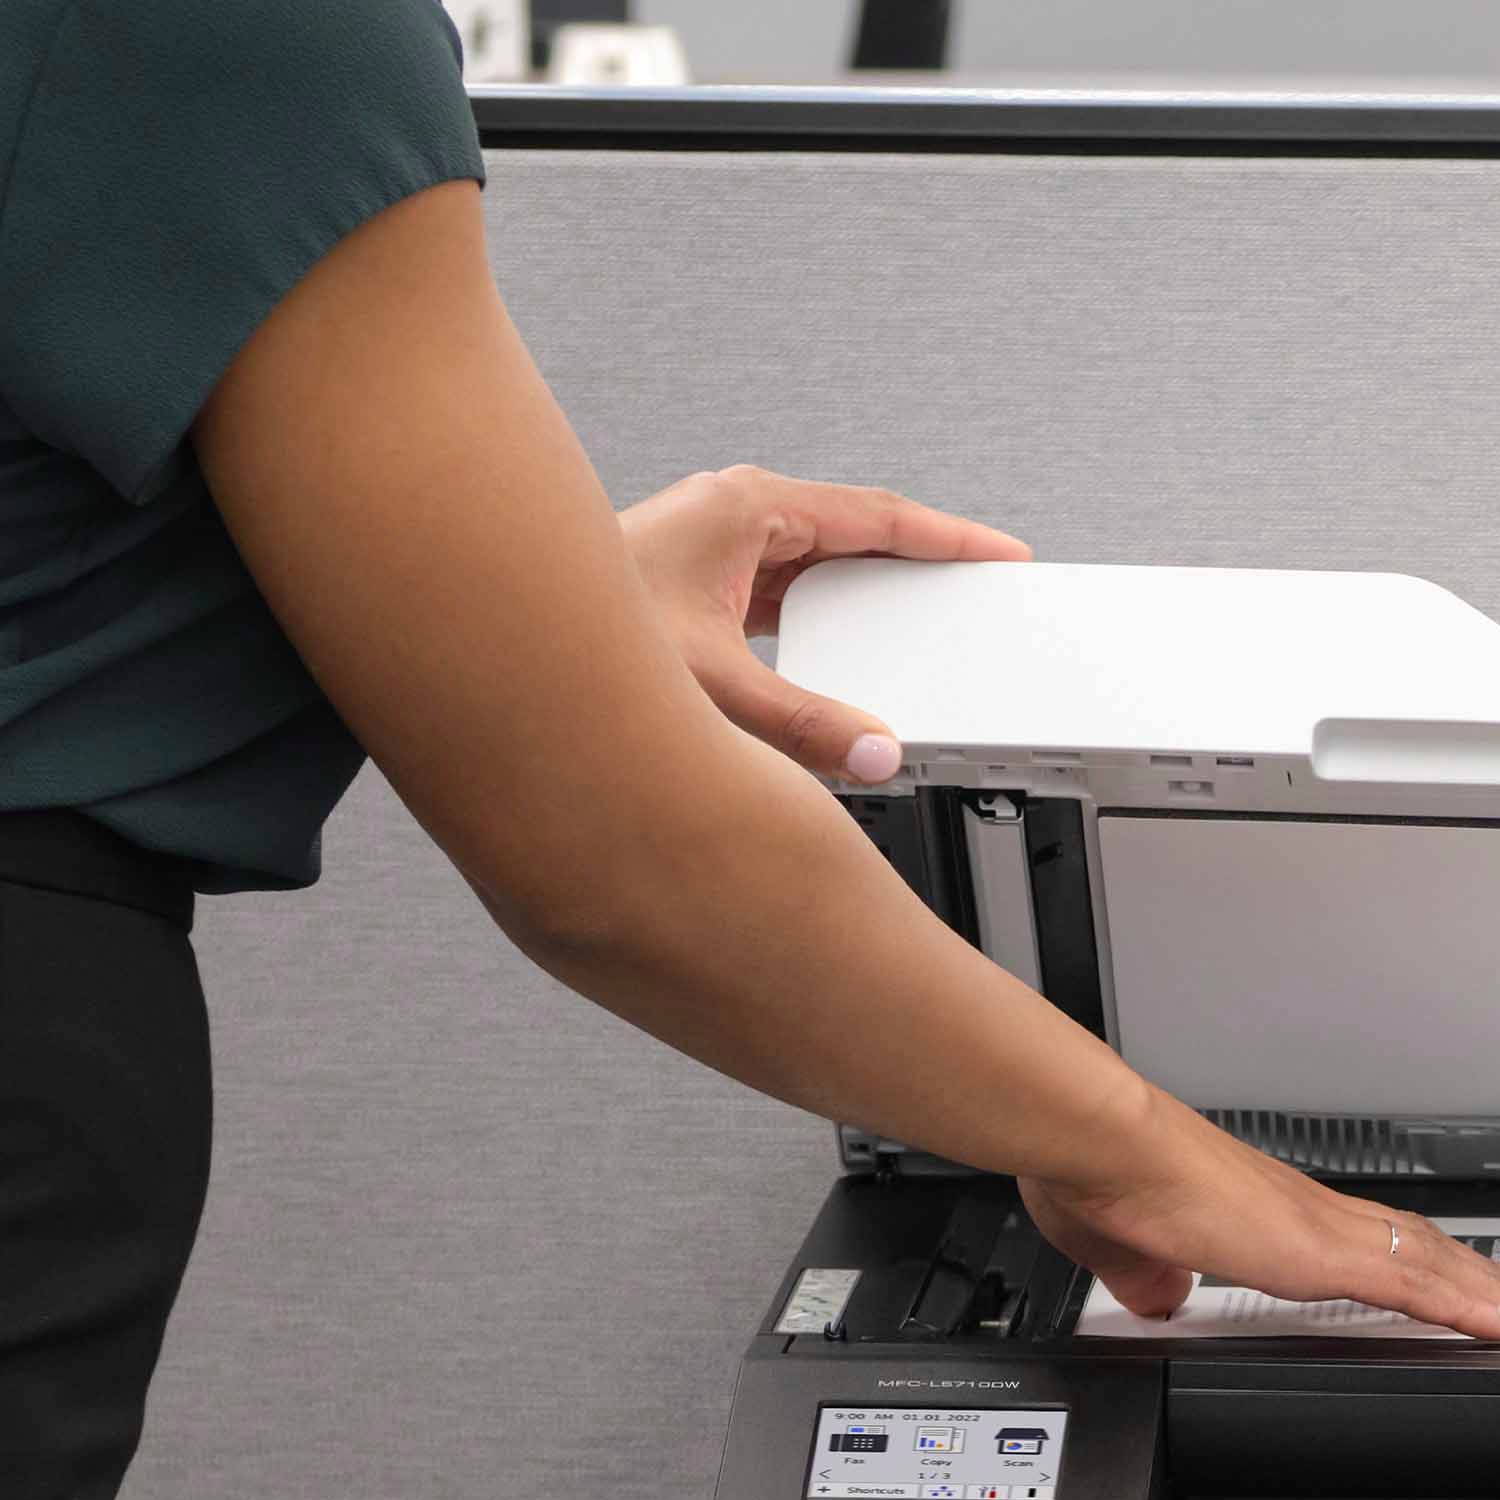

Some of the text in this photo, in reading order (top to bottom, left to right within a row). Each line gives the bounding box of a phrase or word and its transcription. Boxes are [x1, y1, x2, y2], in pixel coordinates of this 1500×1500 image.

[835, 1412, 866, 1420] 9:00
[844, 1457, 865, 1465] Fax
[921, 1458, 952, 1467] Copy
[1003, 1459, 1034, 1467] Scan
[847, 1486, 905, 1496] Shortcuts
